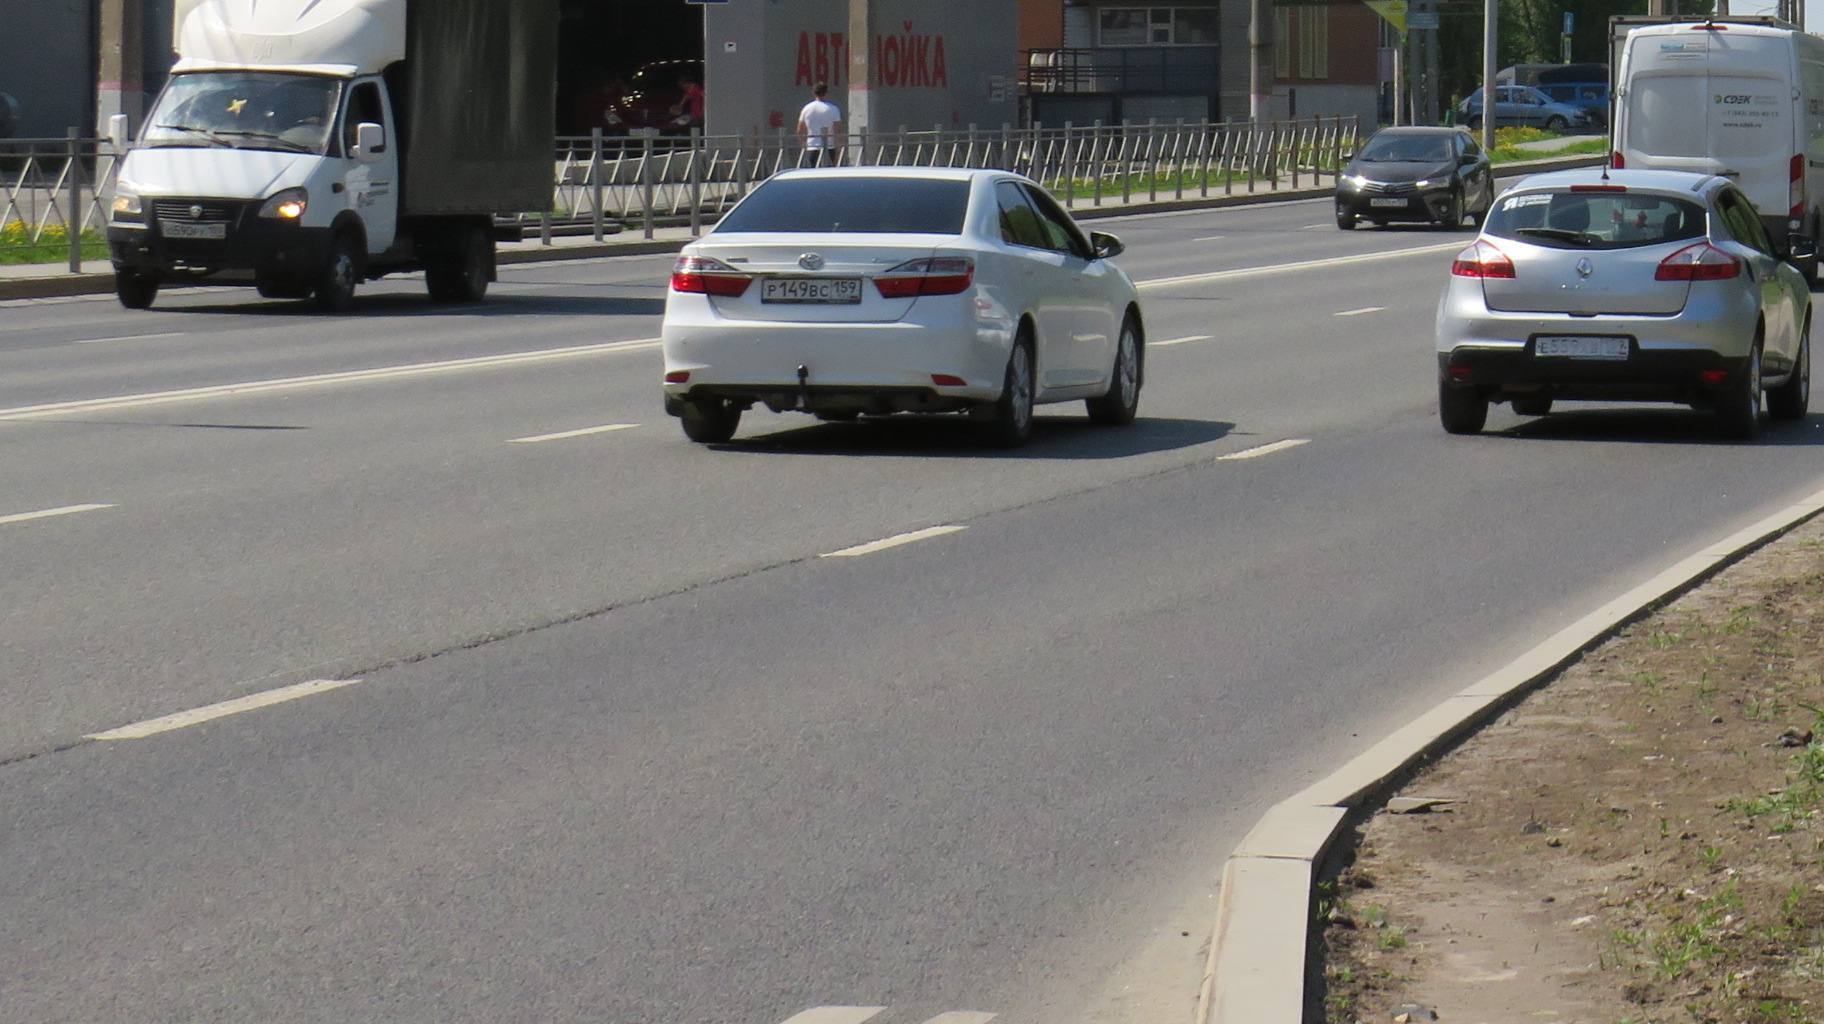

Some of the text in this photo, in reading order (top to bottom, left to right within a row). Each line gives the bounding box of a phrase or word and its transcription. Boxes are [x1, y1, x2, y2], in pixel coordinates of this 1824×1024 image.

[795, 20, 948, 87] АВТОЙКА
[1723, 95, 1752, 104] CDEK
[767, 280, 857, 298] Р149ВС 159
